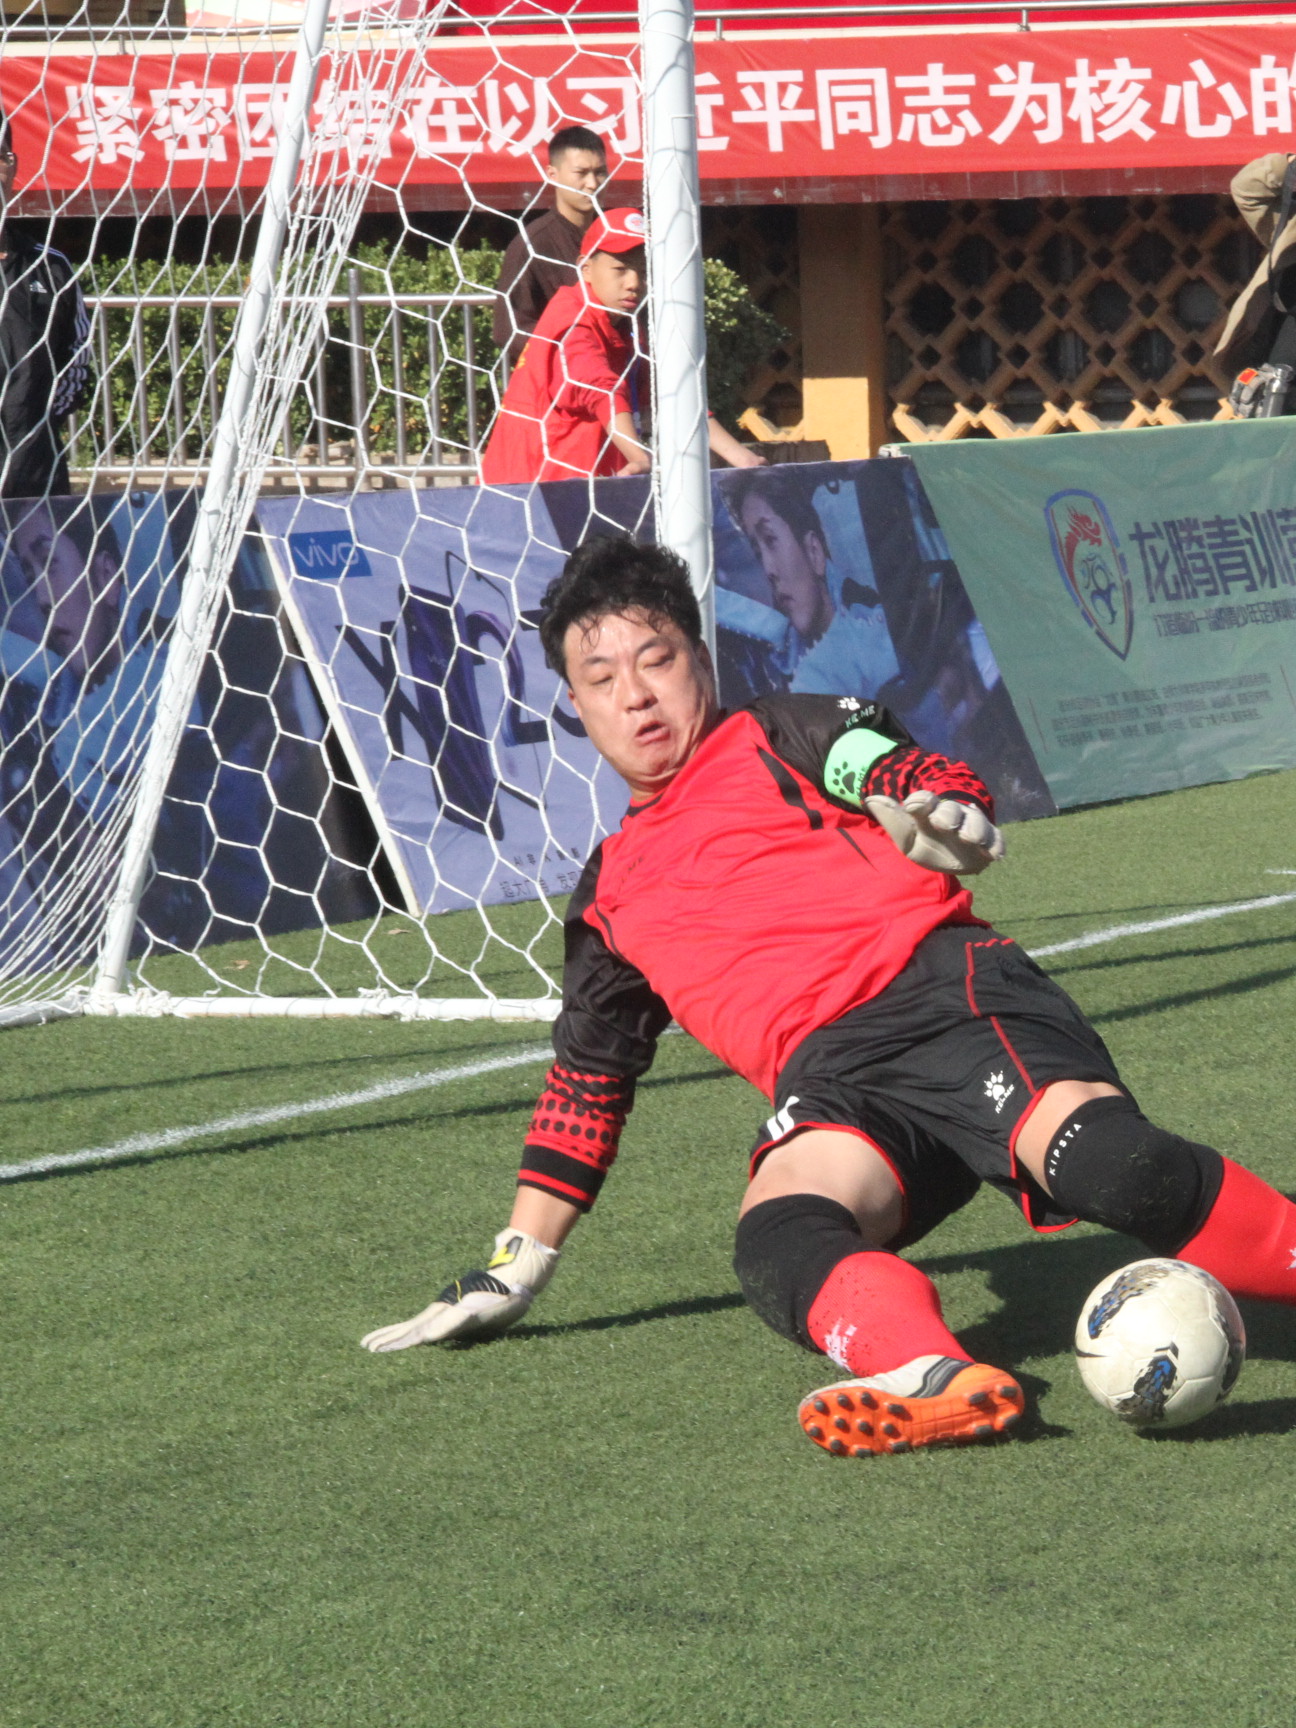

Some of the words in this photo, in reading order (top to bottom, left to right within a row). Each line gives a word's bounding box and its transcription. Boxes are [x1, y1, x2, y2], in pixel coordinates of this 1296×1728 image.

[293, 537, 359, 568] vivo
[995, 1083, 1016, 1114] KELME
[1048, 1122, 1083, 1176] KIPSTA
